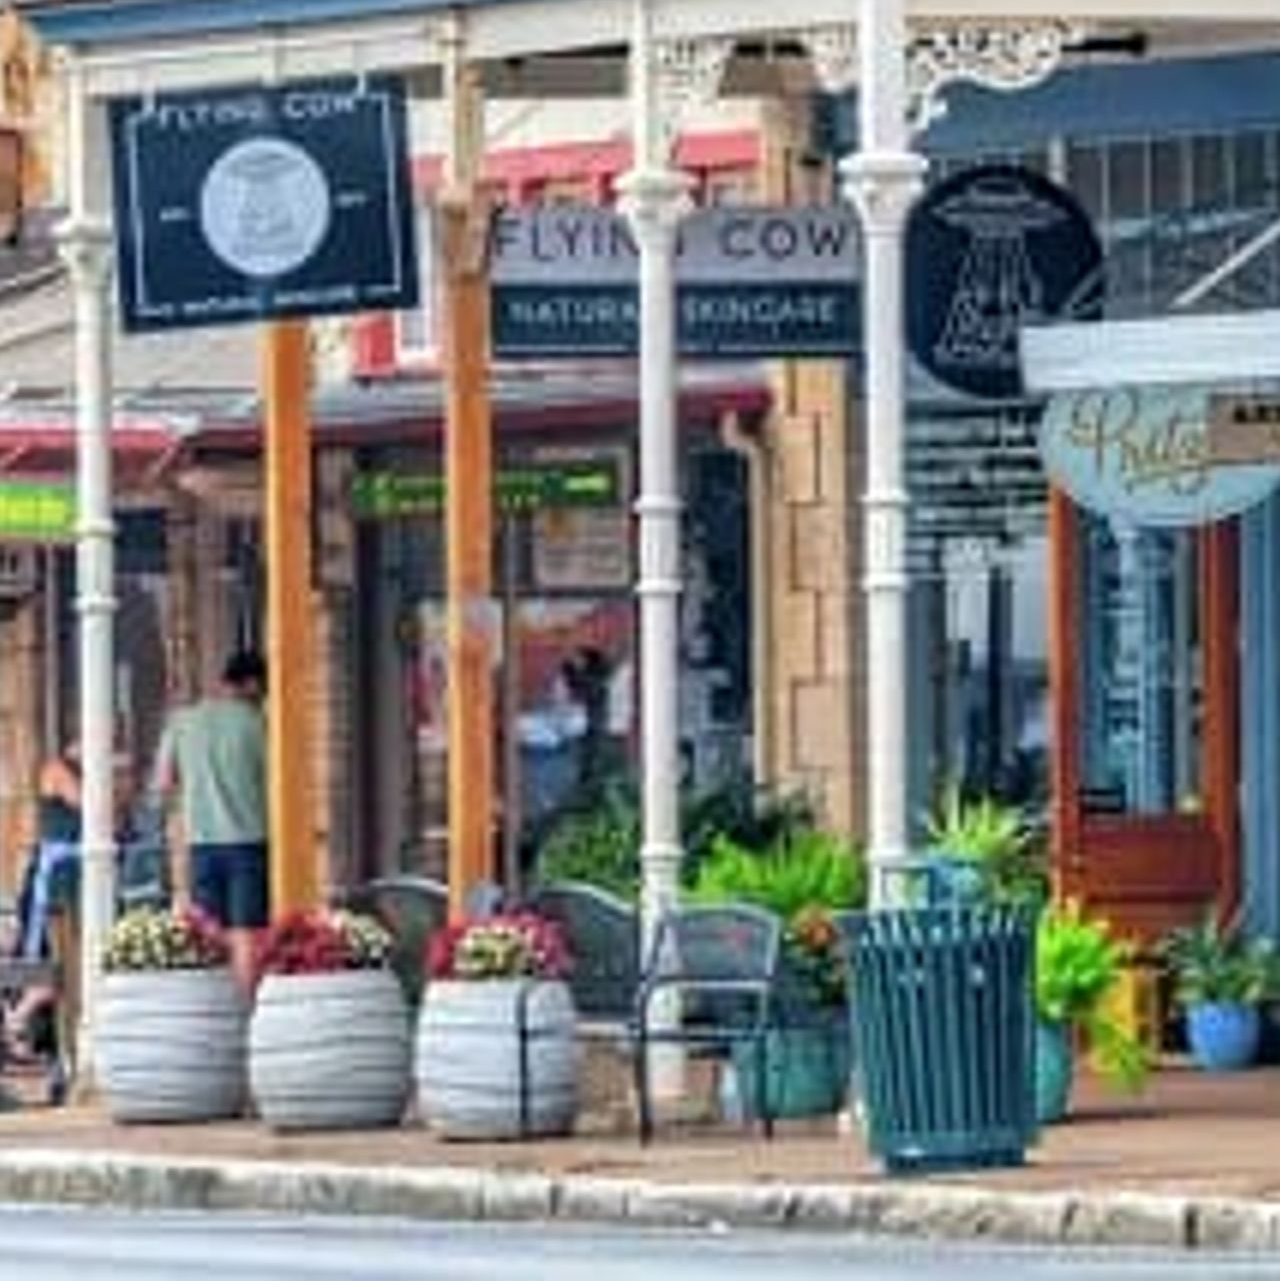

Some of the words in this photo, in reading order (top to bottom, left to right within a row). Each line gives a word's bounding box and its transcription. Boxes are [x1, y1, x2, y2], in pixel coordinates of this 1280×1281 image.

[283, 92, 357, 119] COW
[493, 217, 683, 261] FLYIN
[720, 218, 847, 260] COW
[505, 295, 640, 326] NATURA
[681, 294, 837, 326] SKINCARE
